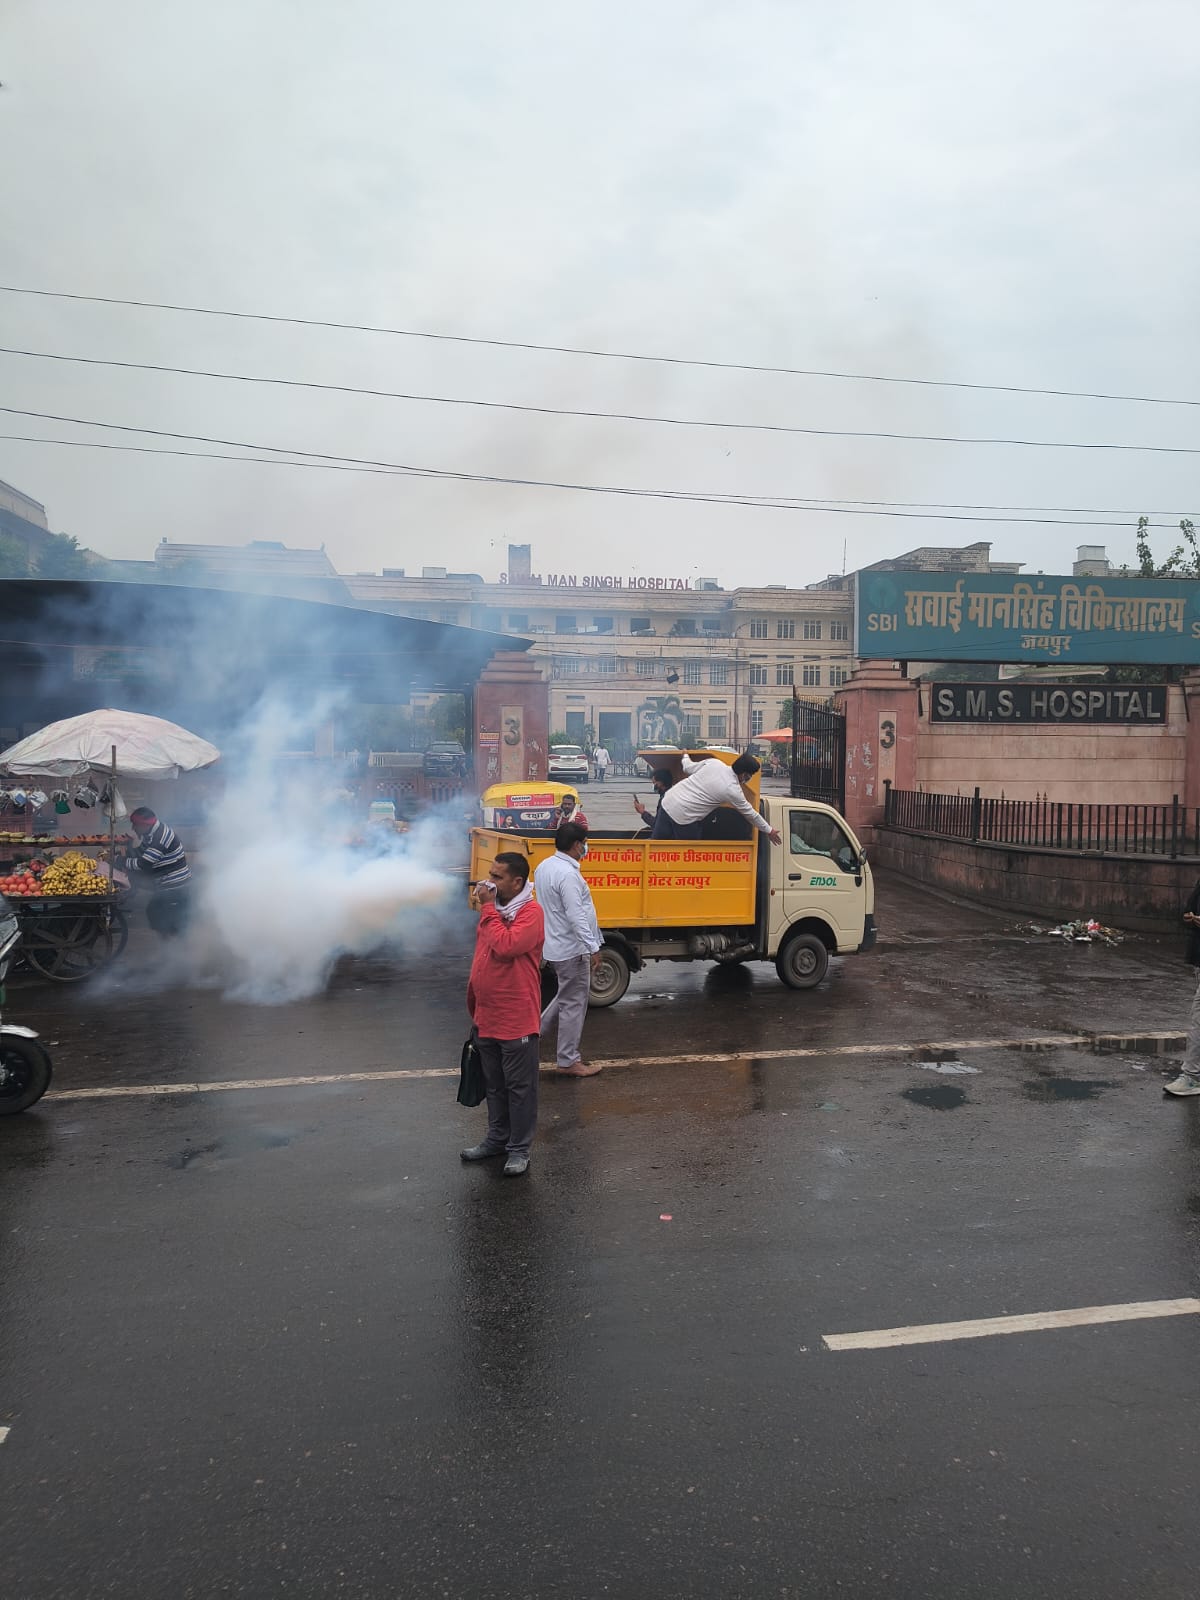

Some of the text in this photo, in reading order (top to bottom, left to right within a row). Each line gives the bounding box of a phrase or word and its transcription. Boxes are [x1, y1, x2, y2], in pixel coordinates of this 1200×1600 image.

[498, 572, 692, 591] SAI MAN SINGH HOSPITAL
[904, 579, 1187, 633] सवाई मानसिंह चिकित्सालय
[866, 613, 898, 632] SBI
[1020, 634, 1073, 656] जयपुर
[936, 688, 1161, 719] S.M.S. HOSPITAL
[504, 717, 520, 746] 3
[880, 720, 895, 749] 3
[621, 848, 642, 863] कीट
[648, 851, 680, 863] नाशक
[724, 851, 750, 863] वाहन
[584, 876, 605, 887] गर
[606, 873, 640, 887] निगम
[675, 876, 712, 889] जयपुर
